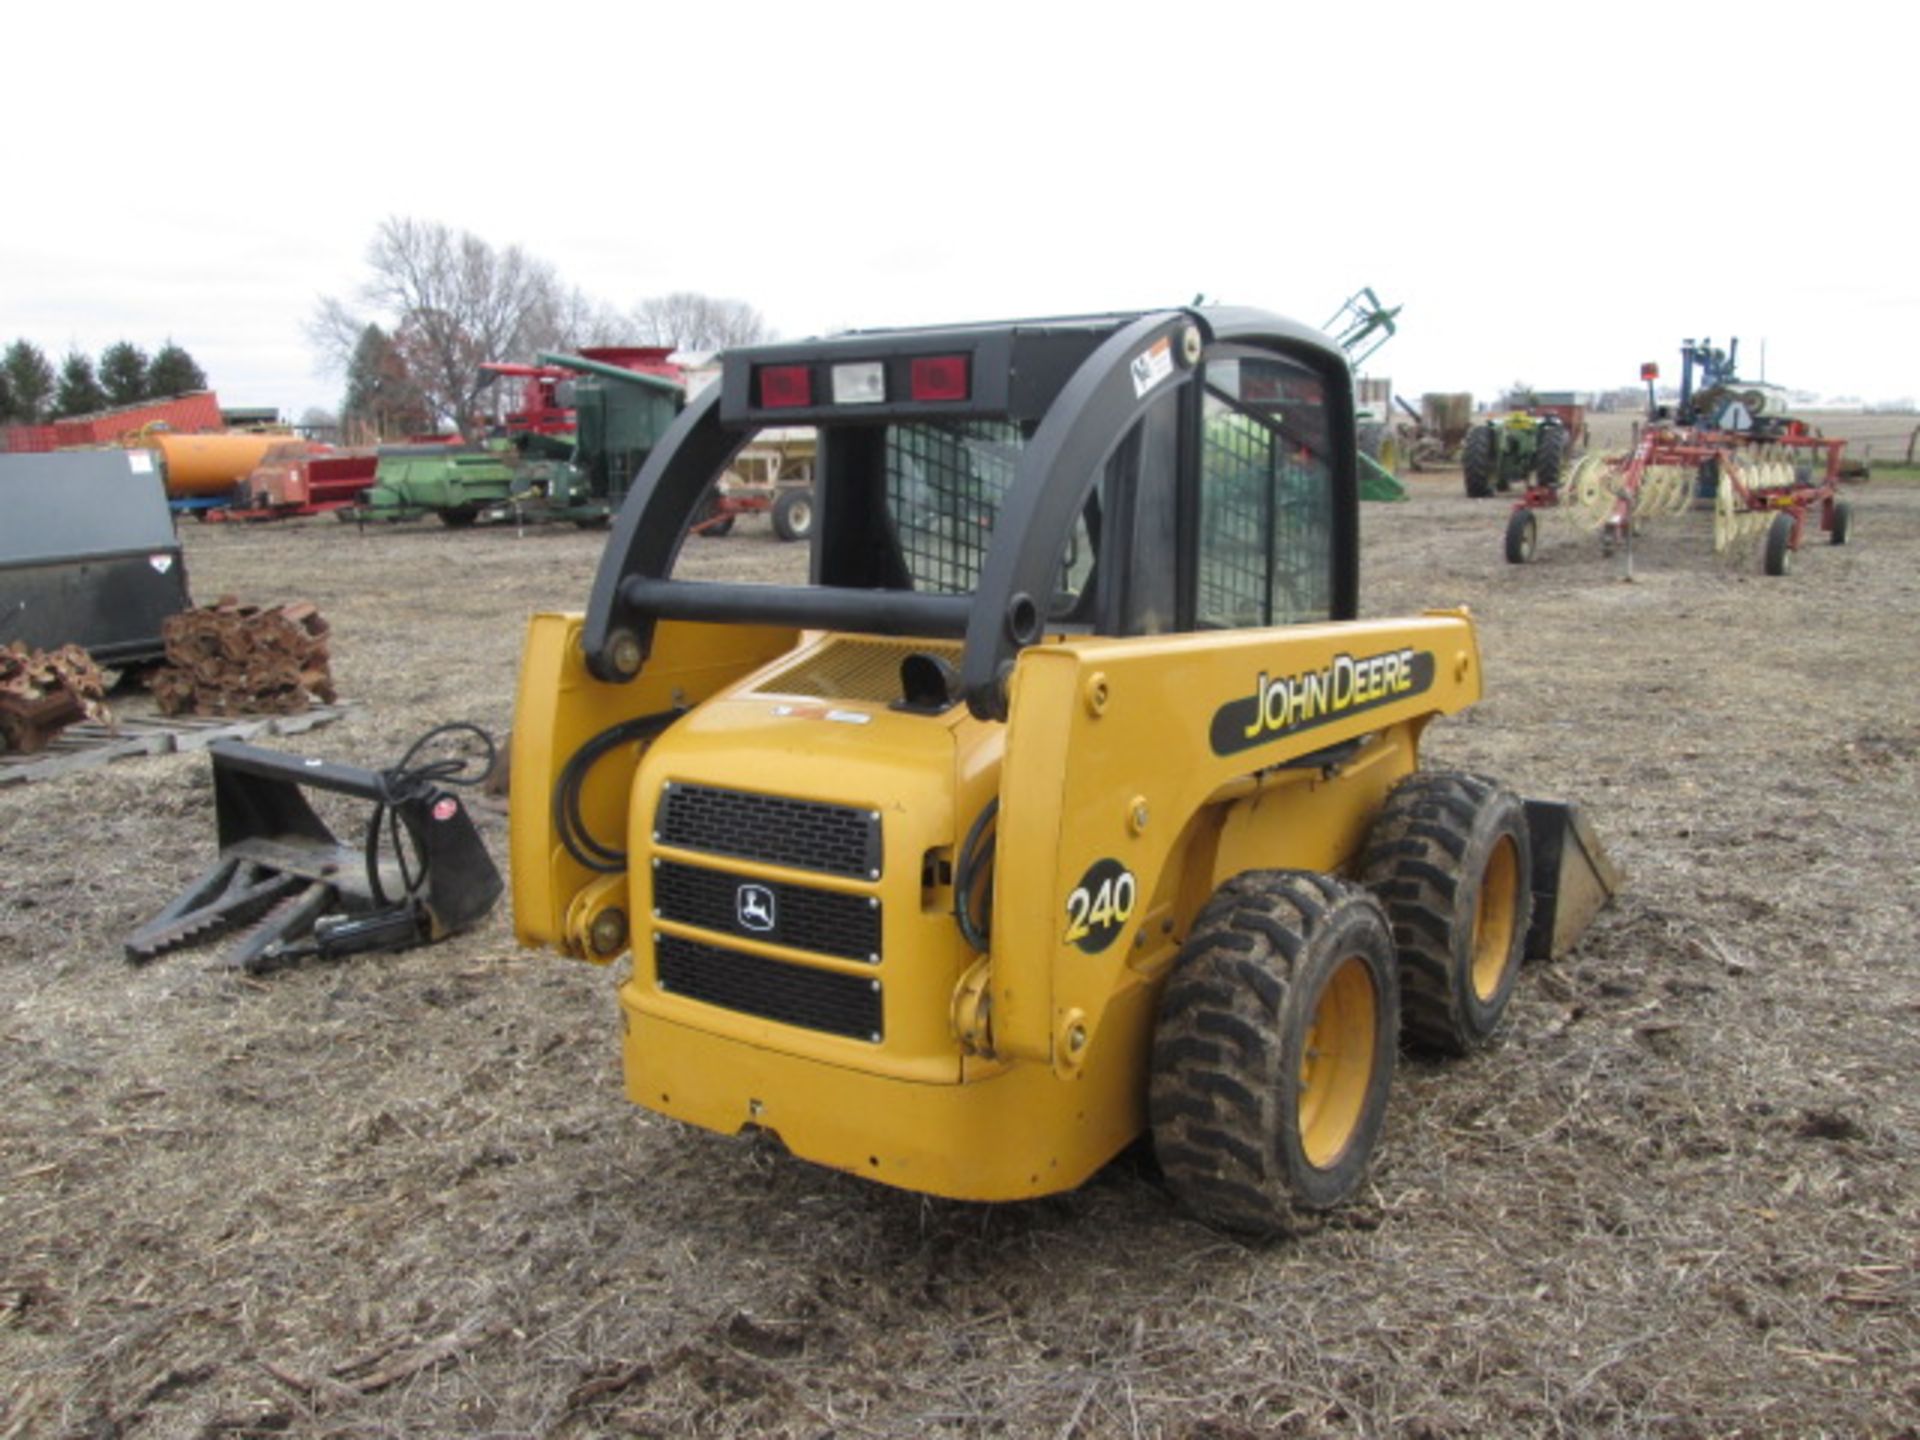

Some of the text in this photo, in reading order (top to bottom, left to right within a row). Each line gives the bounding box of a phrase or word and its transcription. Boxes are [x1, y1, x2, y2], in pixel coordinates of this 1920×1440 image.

[1245, 650, 1414, 738] JOHN DEERE
[1065, 872, 1135, 942] 240
